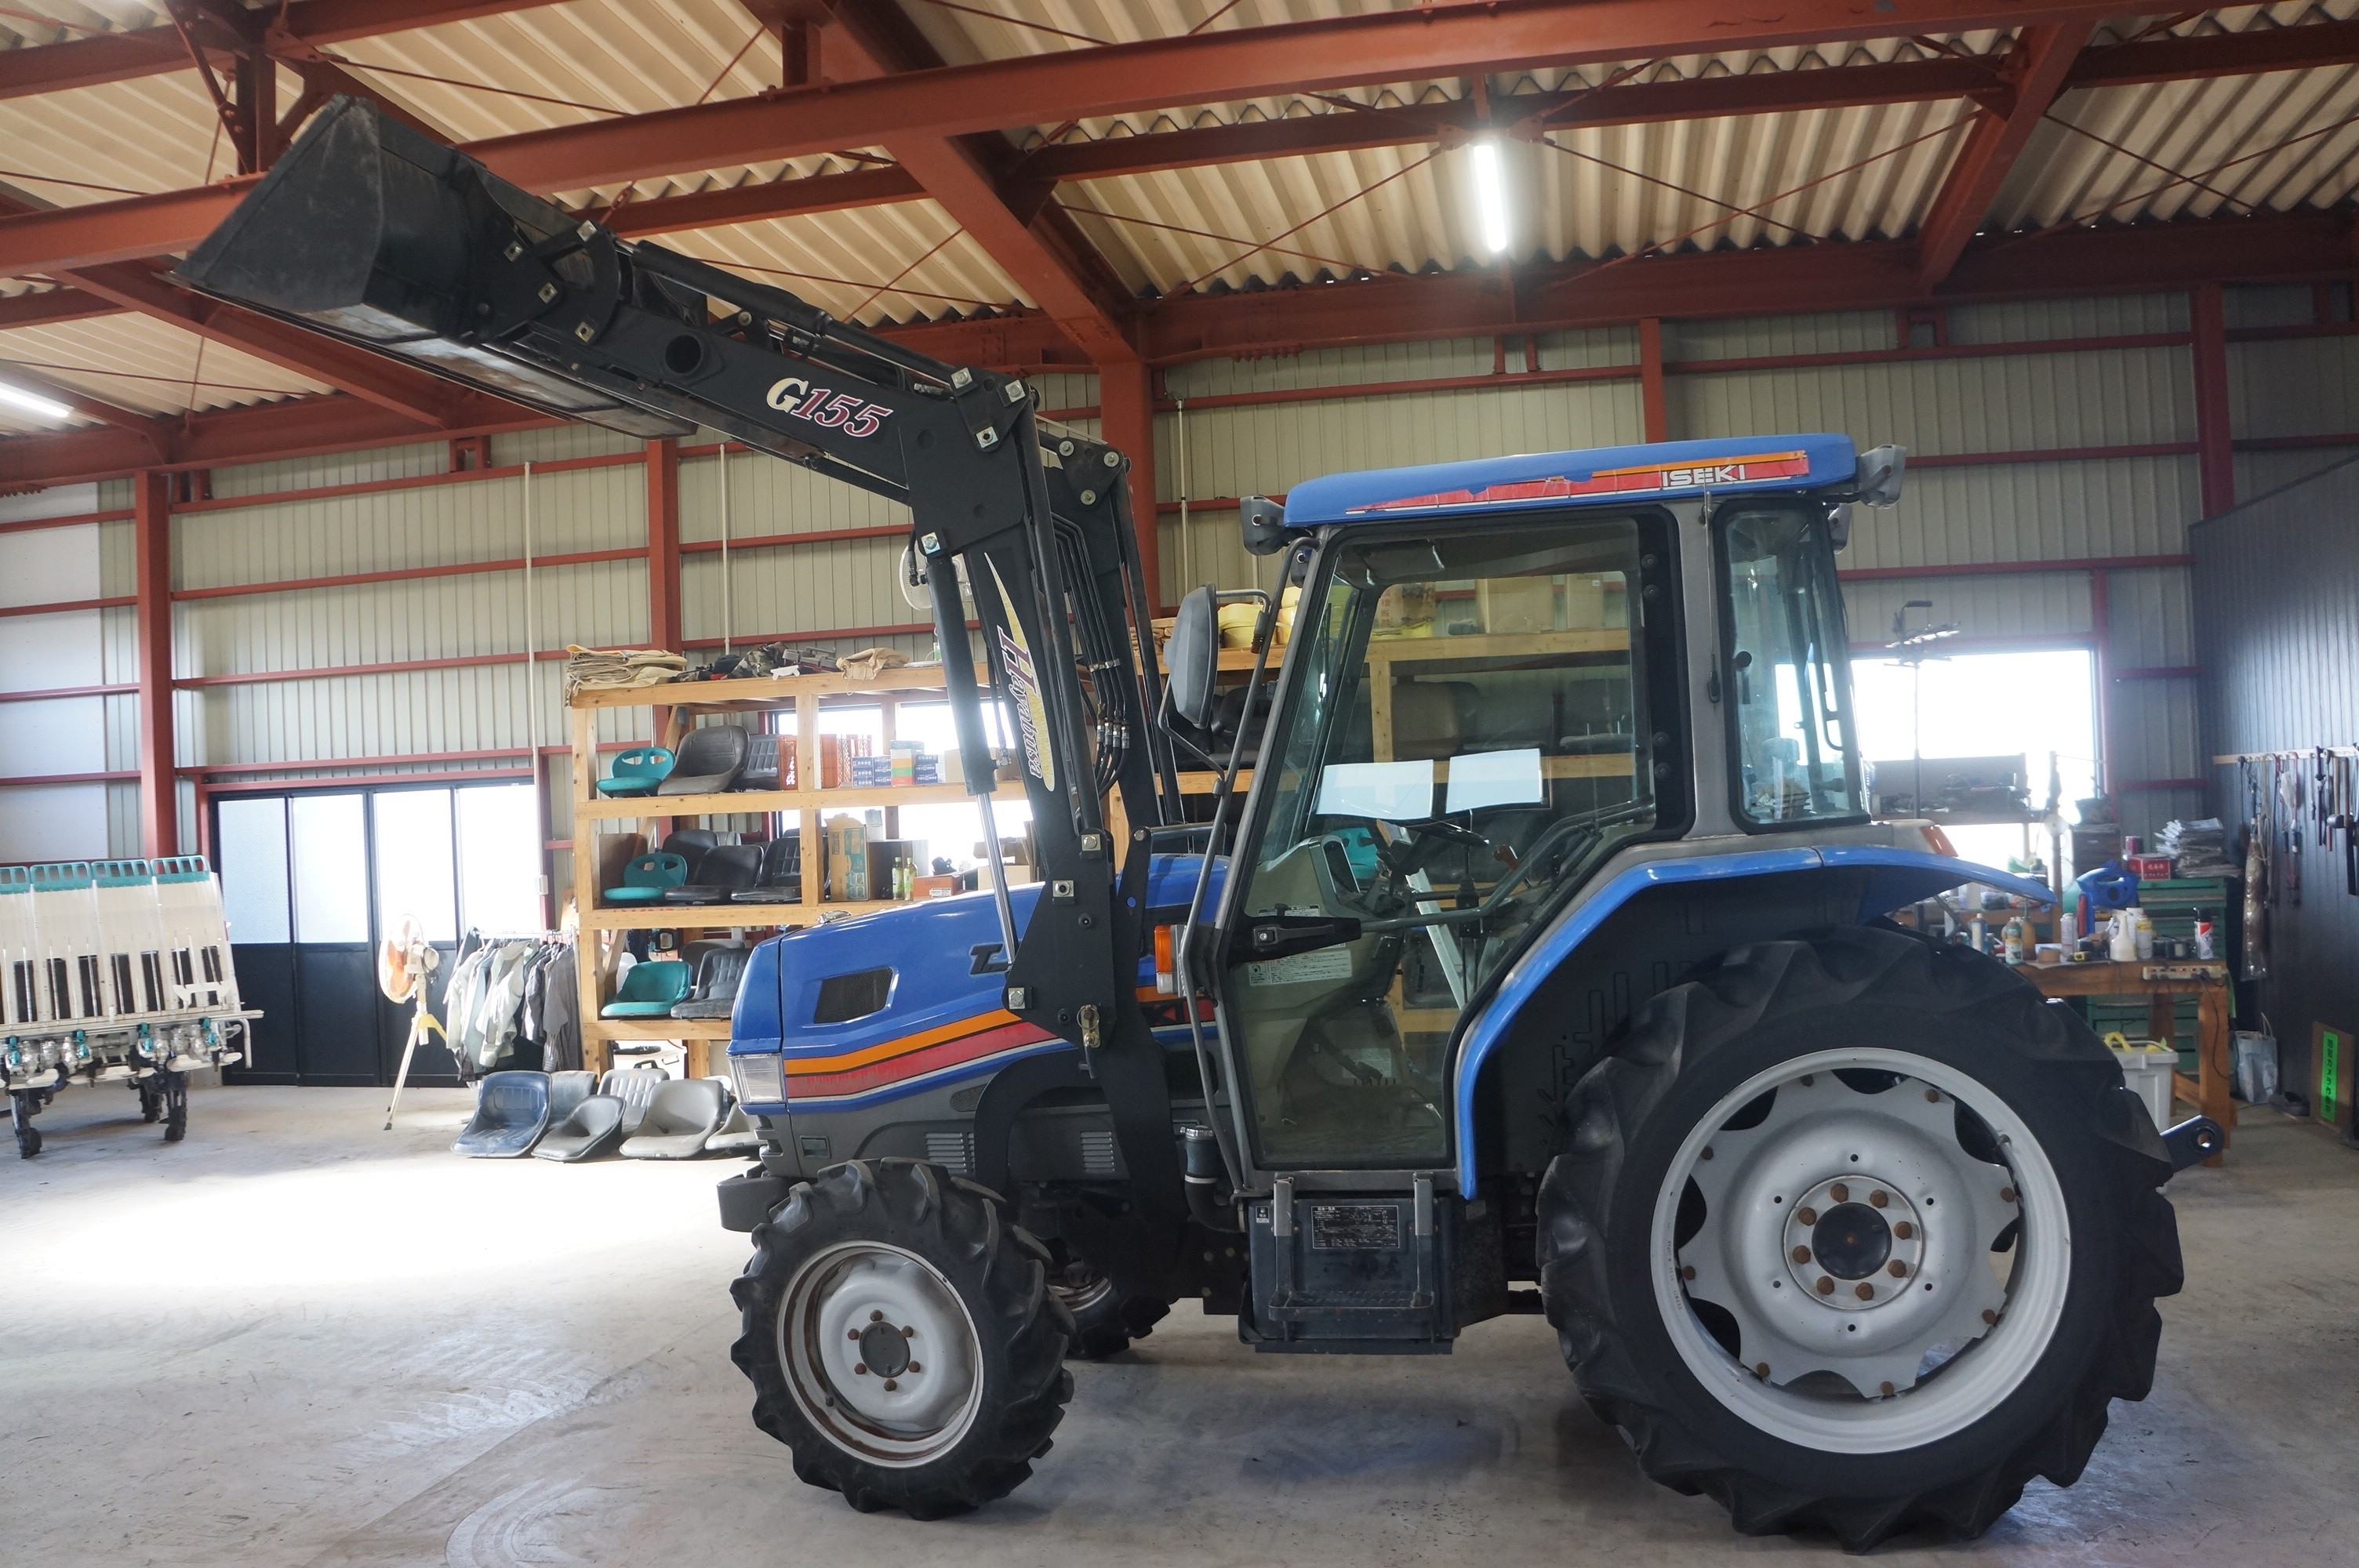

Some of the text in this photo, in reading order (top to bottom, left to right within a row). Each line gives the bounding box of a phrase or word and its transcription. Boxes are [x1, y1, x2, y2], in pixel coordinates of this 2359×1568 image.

[766, 377, 894, 437] G155
[1662, 465, 1746, 487] ISEKI
[997, 625, 1043, 779] Hayabusa
